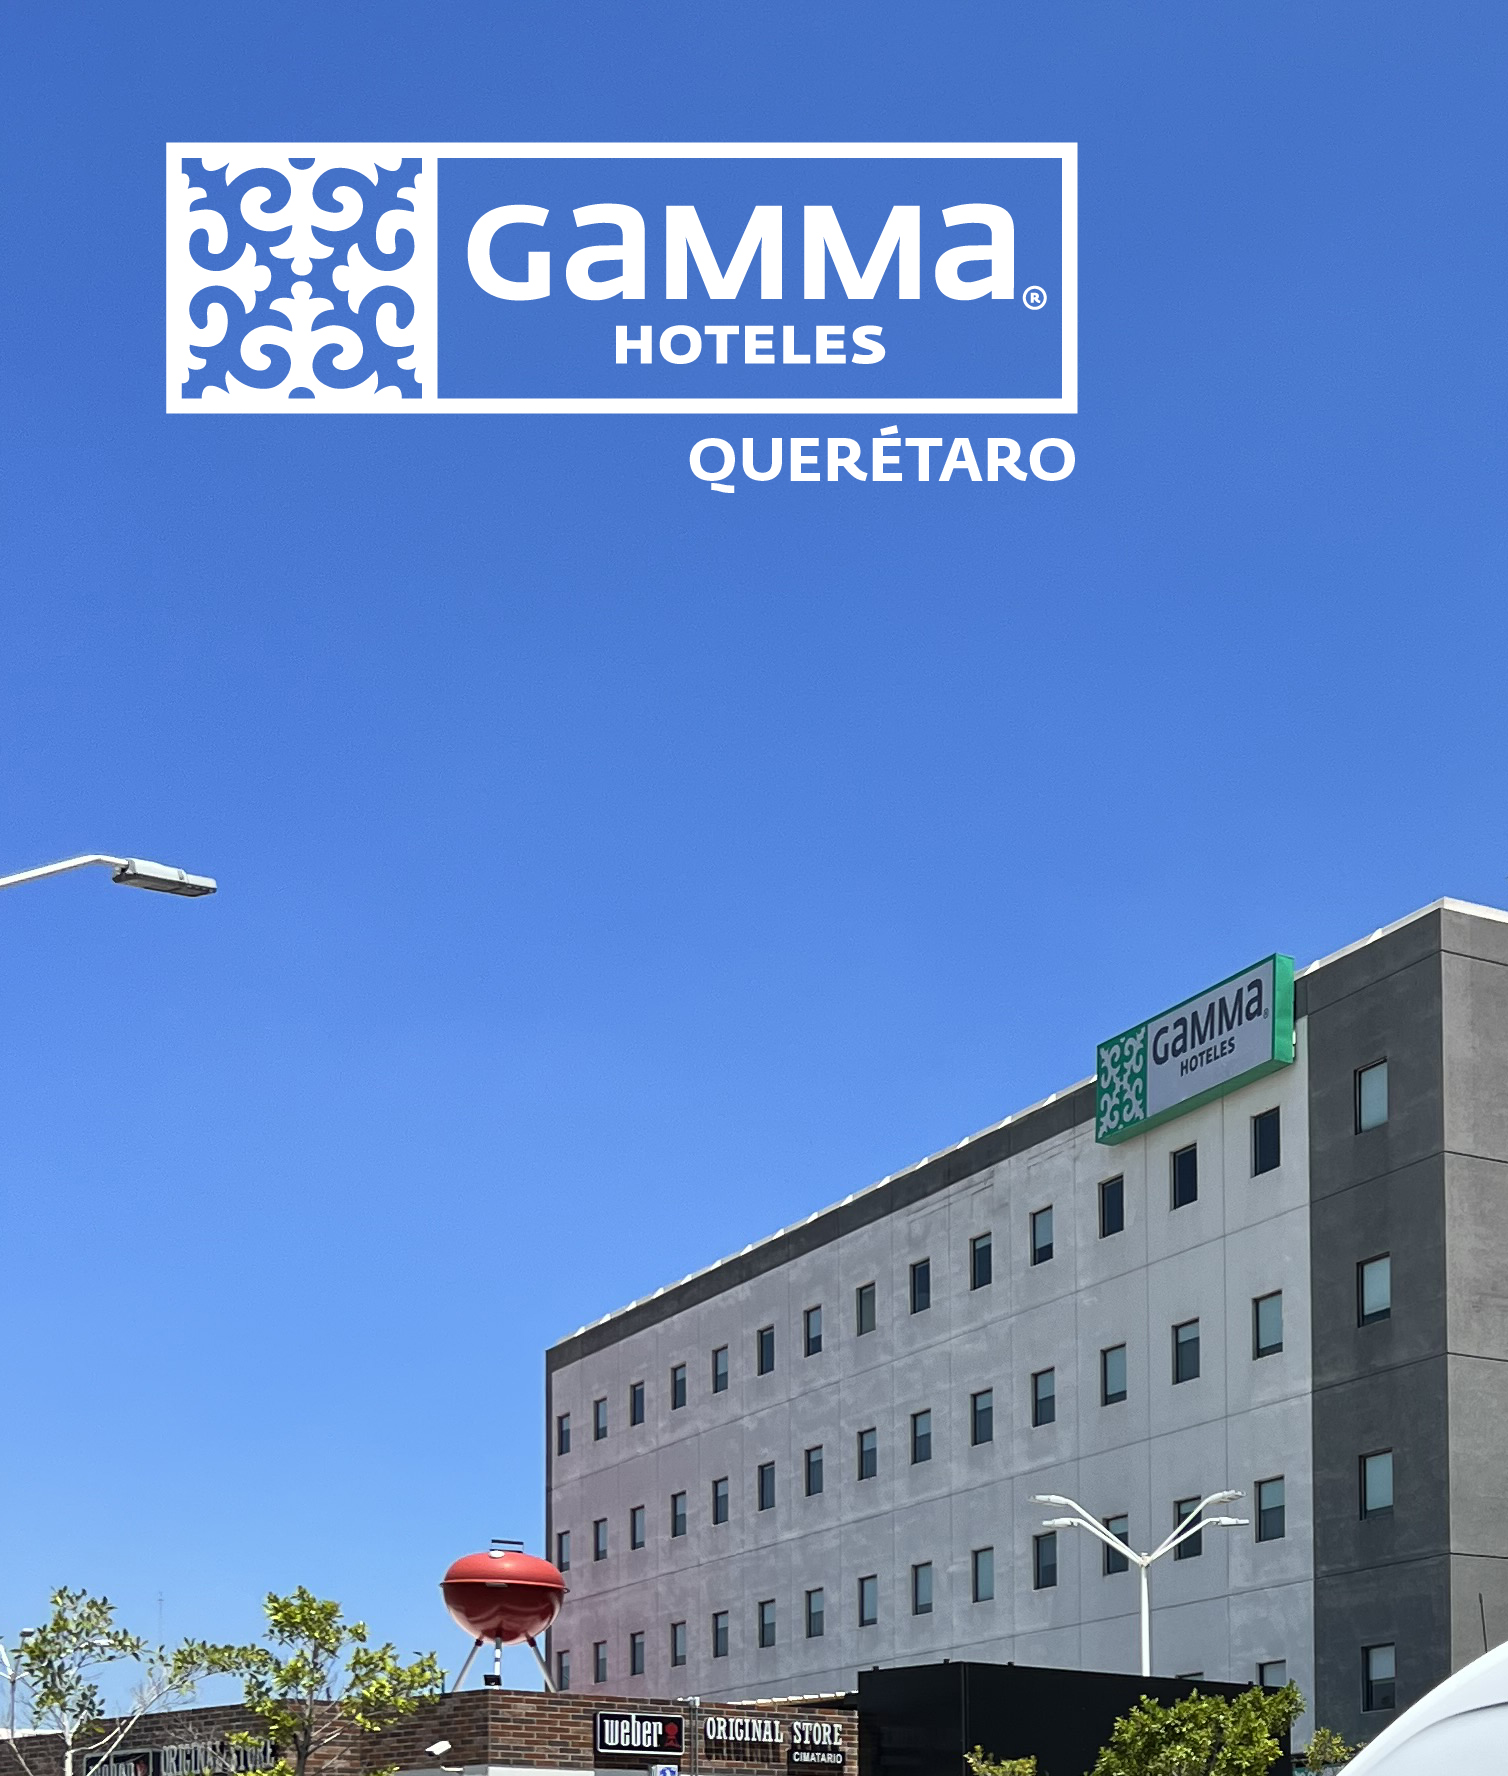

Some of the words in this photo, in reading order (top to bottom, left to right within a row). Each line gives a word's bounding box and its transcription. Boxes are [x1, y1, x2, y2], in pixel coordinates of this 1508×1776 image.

[1180, 1036, 1235, 1077] HOTELES
[604, 1713, 663, 1748] weber
[706, 1716, 784, 1743] ORIGINAL
[792, 1721, 843, 1746] STORE
[792, 1751, 843, 1765] CIMATARIO
